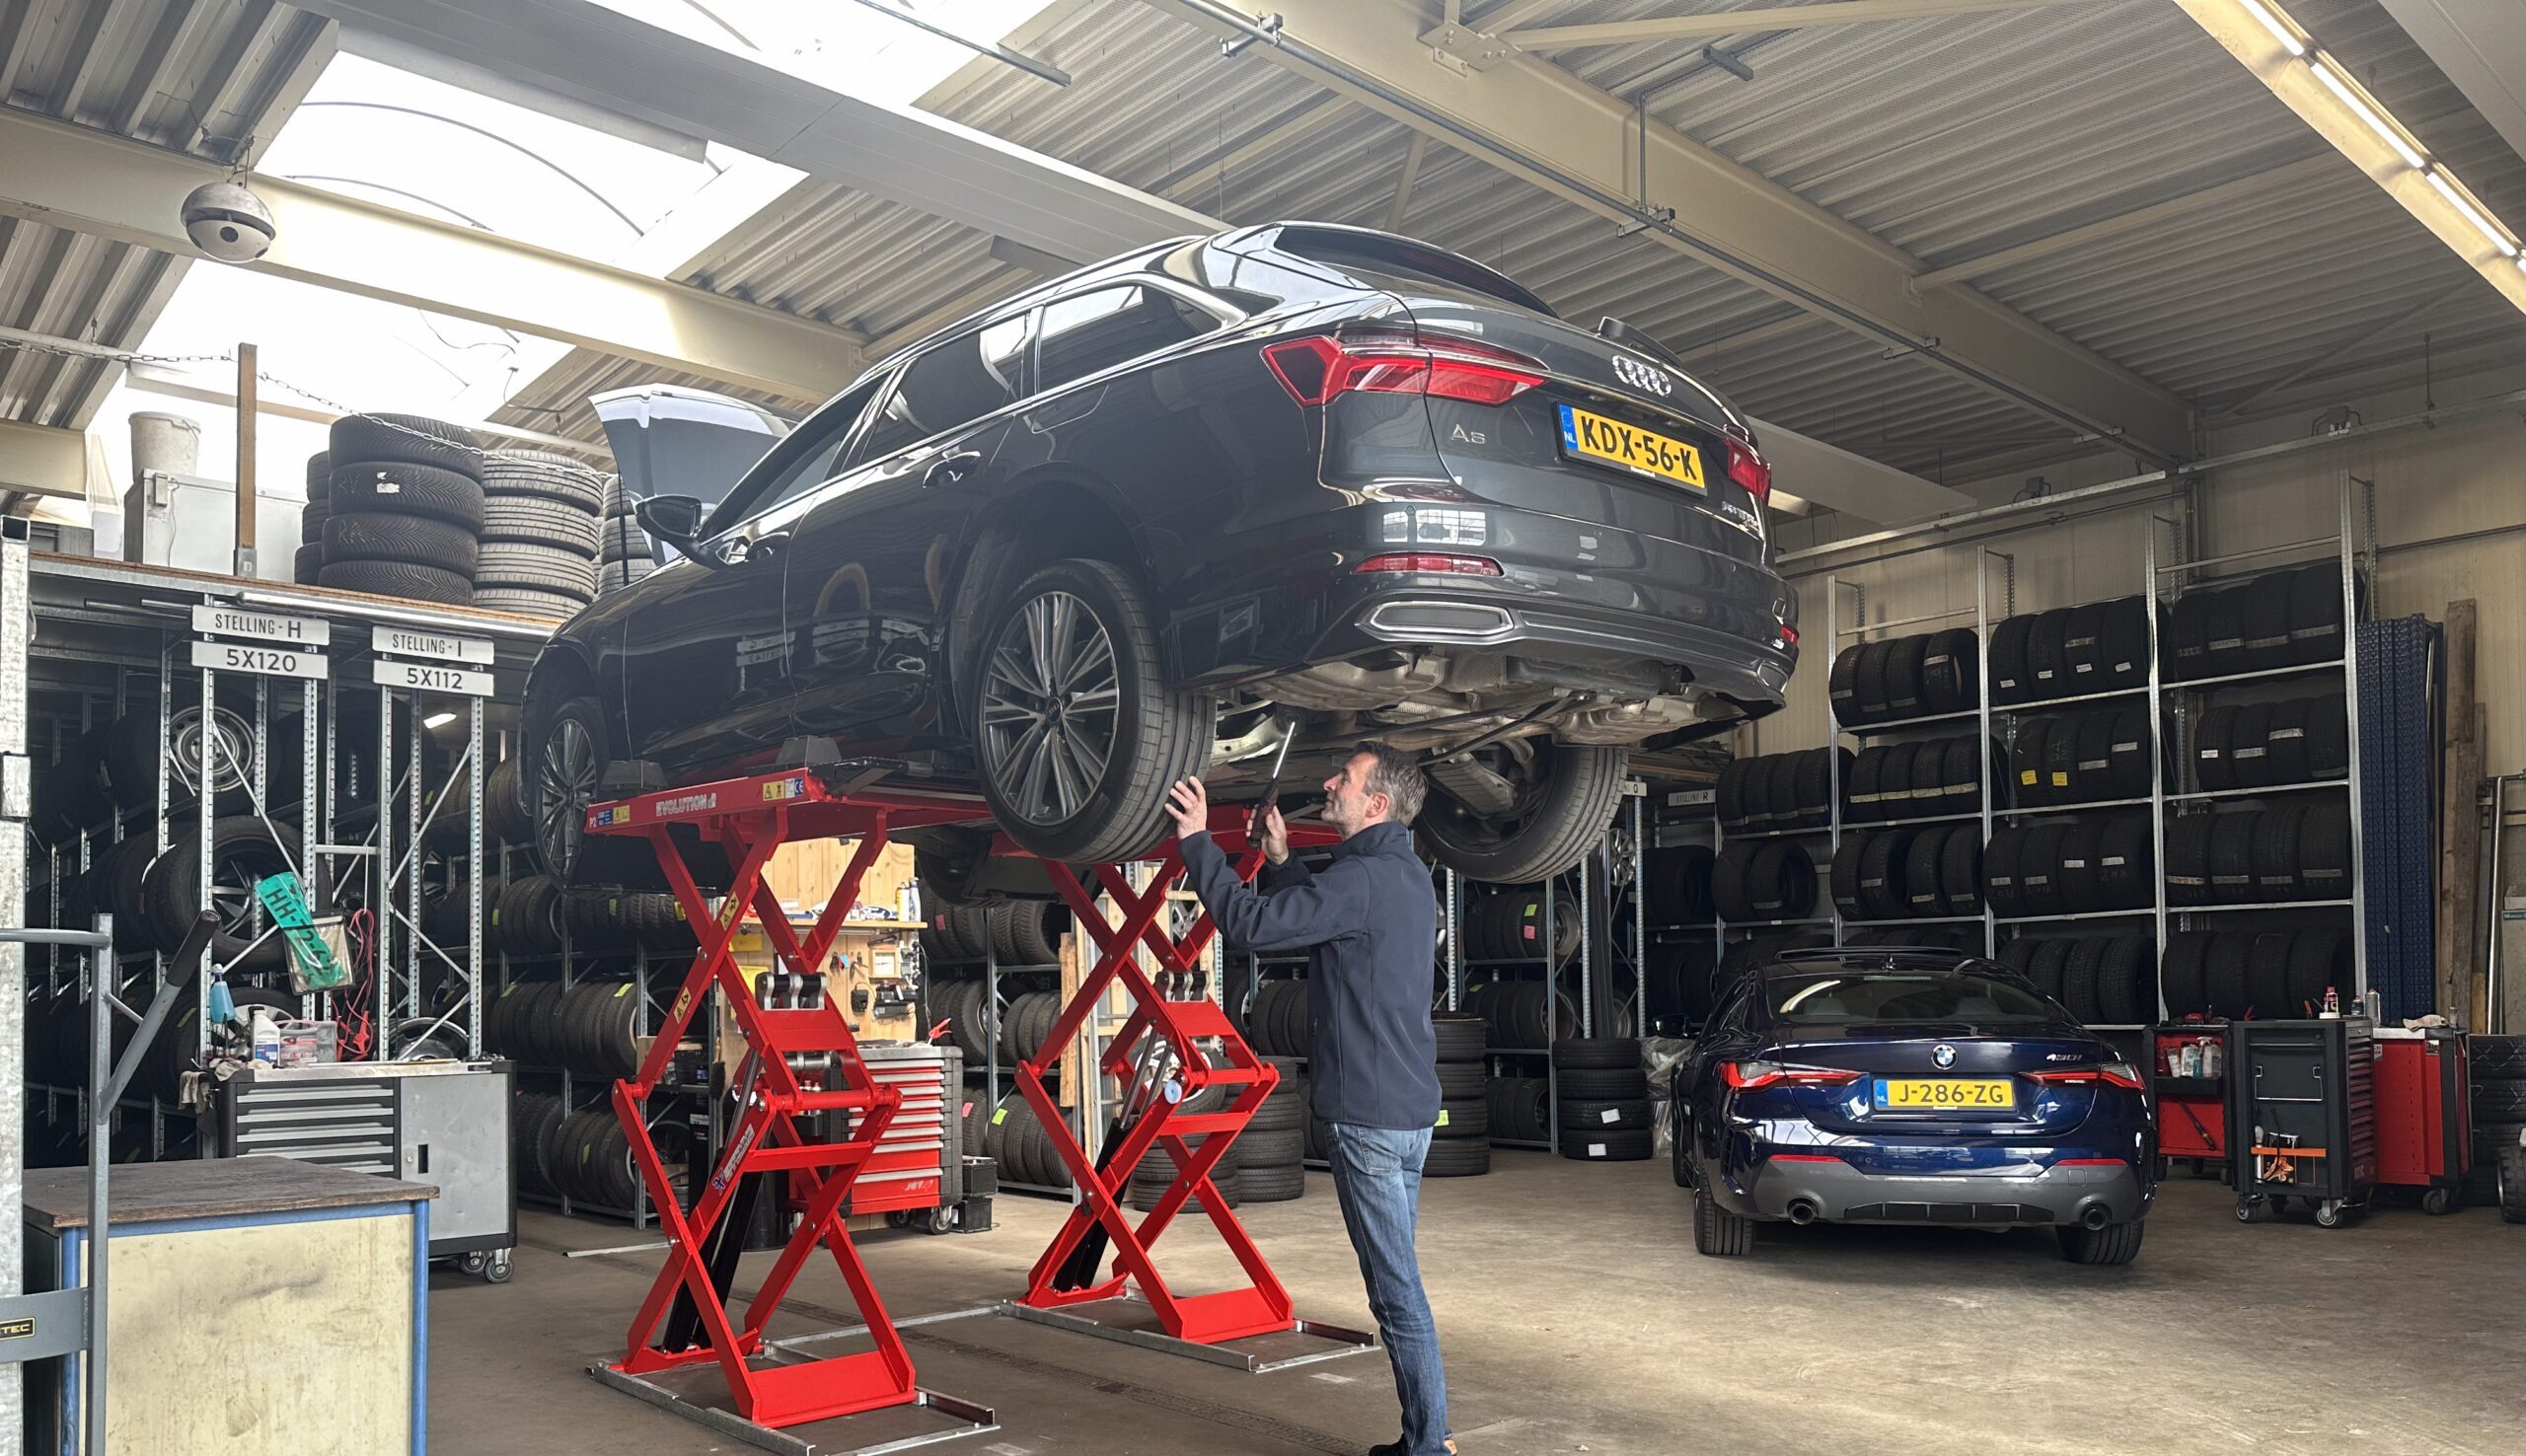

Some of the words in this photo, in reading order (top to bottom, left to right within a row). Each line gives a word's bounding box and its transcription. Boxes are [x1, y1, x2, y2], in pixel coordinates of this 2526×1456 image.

[1564, 432, 1576, 444] NL
[1581, 415, 1698, 480] KDX-56-K
[226, 648, 297, 673] 5X120
[407, 667, 463, 690] 5X112
[1898, 1083, 2004, 1104] J-286-ZG
[0, 1324, 30, 1334] TEC
